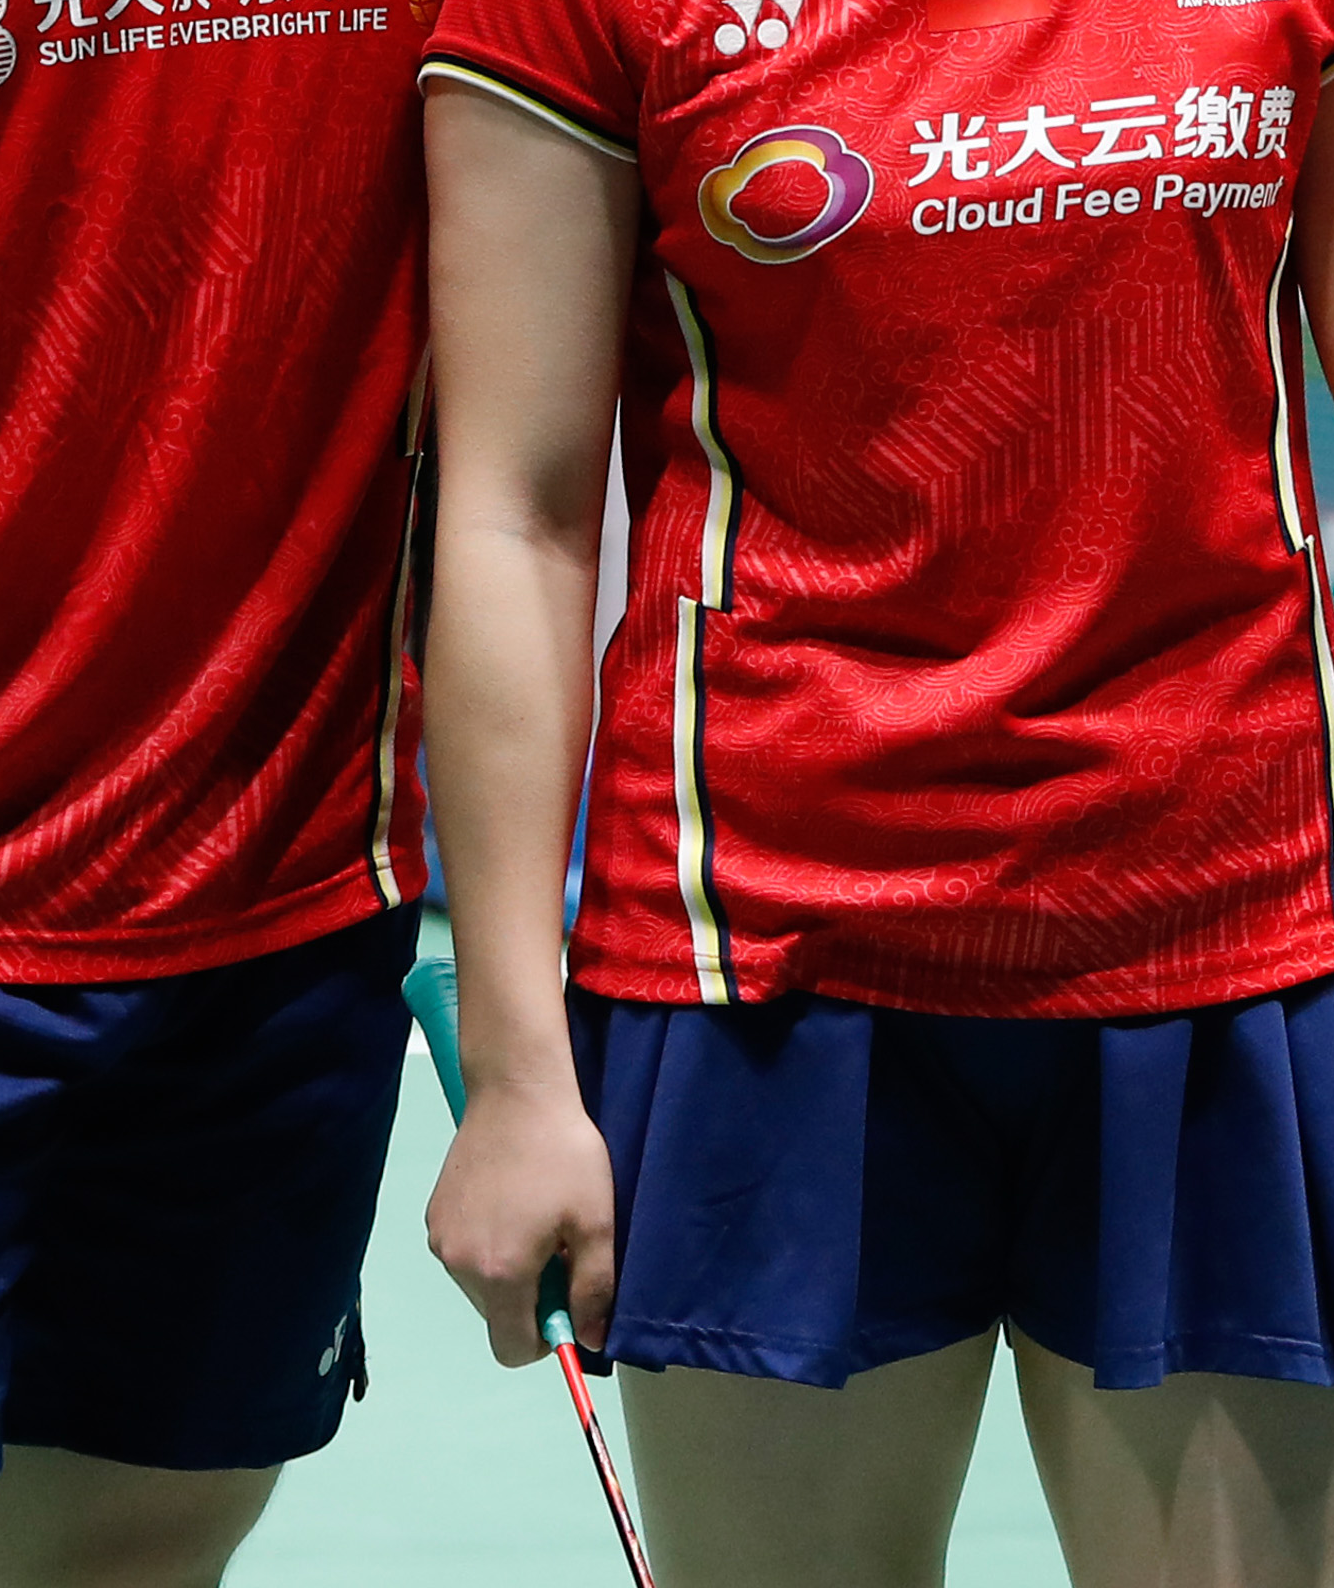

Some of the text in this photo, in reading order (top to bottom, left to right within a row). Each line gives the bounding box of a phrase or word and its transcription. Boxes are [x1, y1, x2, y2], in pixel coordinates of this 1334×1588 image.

[39, 7, 388, 65] SUN LIFE EVERBRIGHT LIFE
[907, 85, 1296, 188] 光大云缴费
[911, 173, 1285, 236] Cloud Fee Payment
